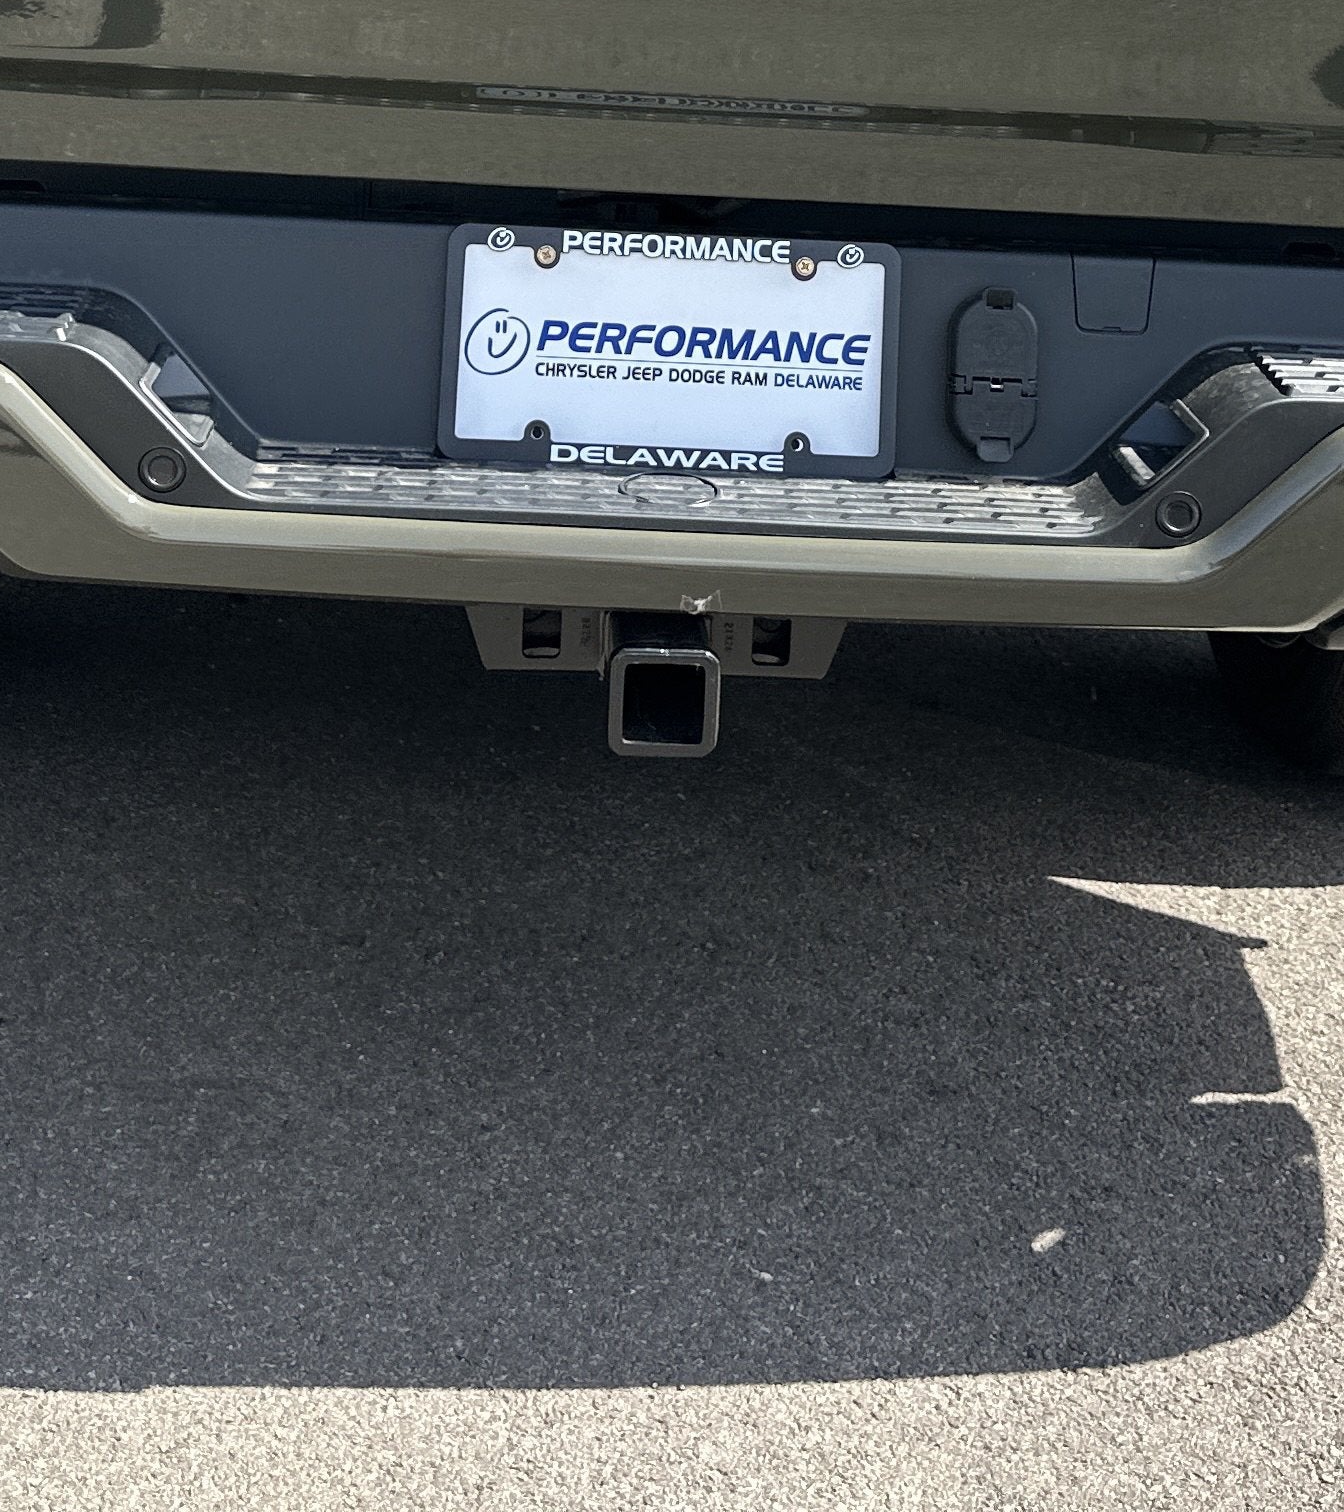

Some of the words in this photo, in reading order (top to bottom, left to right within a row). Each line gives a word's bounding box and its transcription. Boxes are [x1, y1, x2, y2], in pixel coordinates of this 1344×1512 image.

[562, 229, 791, 264] PERFORMANCE
[536, 320, 872, 366] PERFORMANCE
[536, 362, 617, 381] CHRYSLER
[622, 365, 663, 383] JEEP
[669, 367, 725, 385] DODGE
[732, 370, 768, 387] RAM
[774, 373, 863, 391] DELAWARE
[550, 444, 785, 473] DELAWARE
